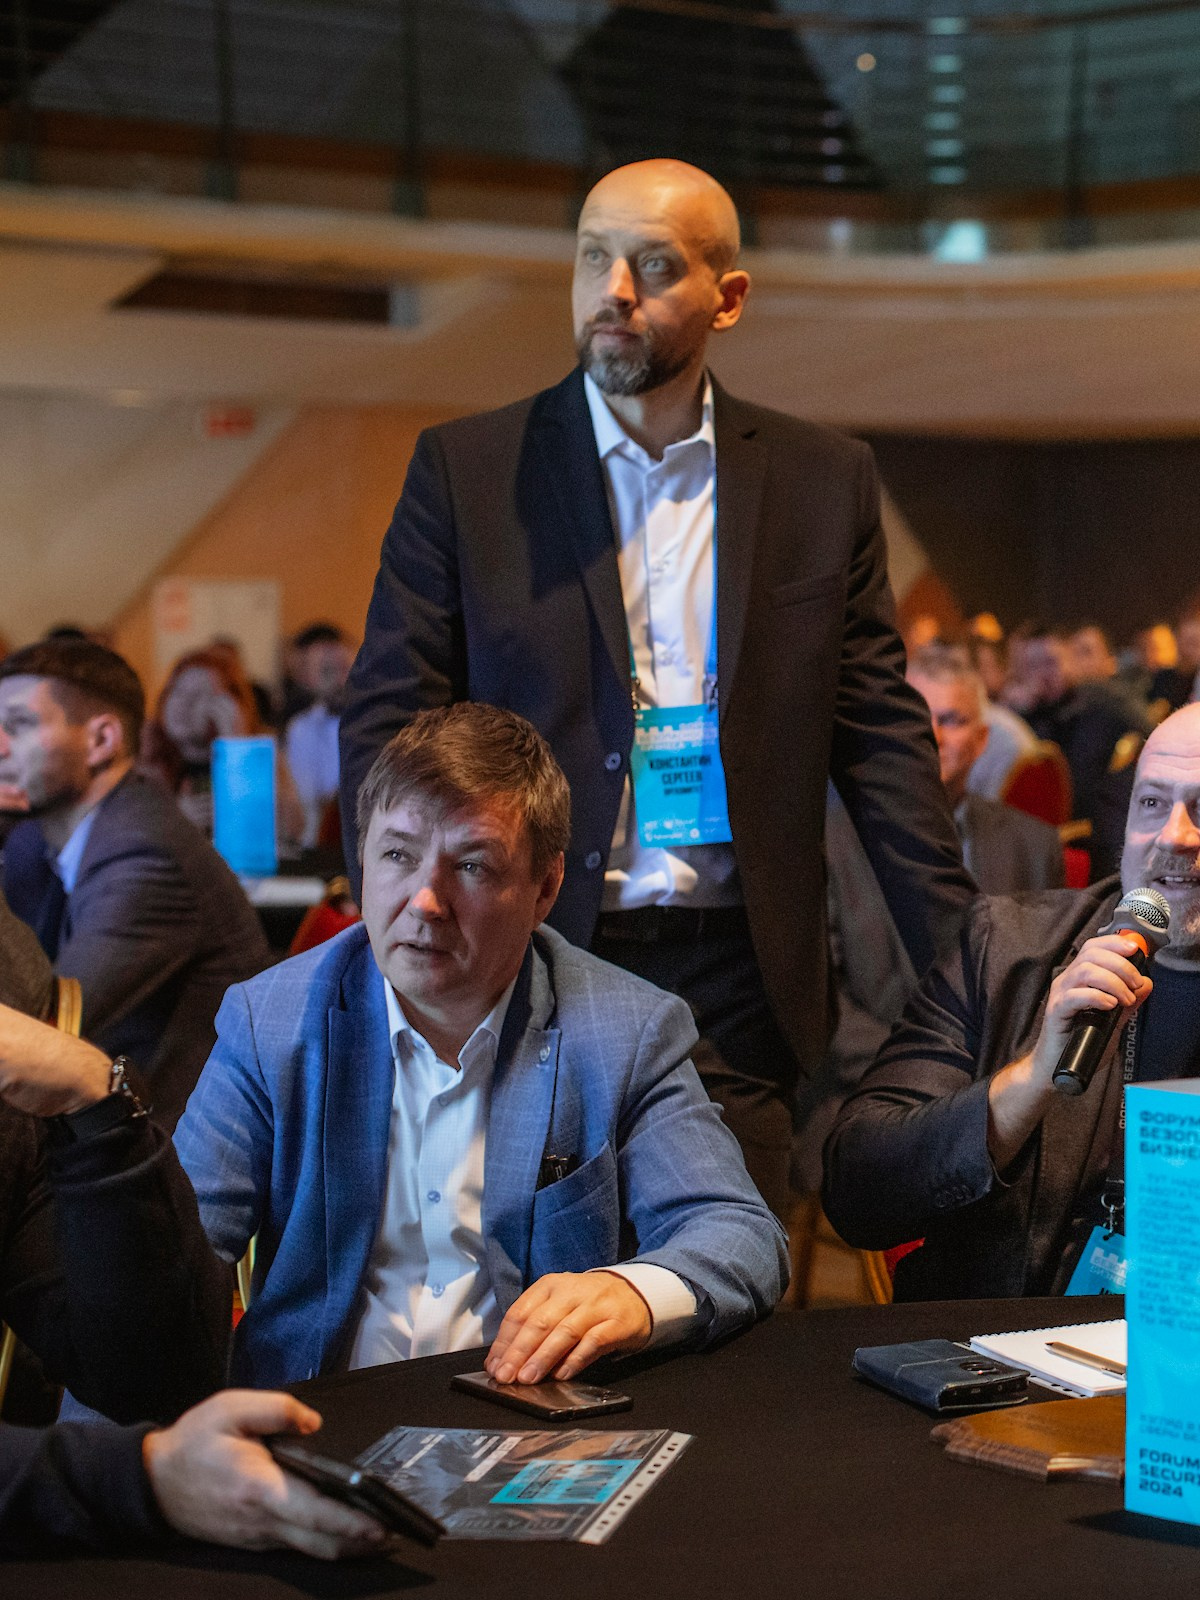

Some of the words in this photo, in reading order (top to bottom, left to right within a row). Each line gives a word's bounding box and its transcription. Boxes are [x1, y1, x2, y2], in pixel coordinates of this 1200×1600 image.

[1123, 1009, 1138, 1081] БЕЗОПАСН
[1139, 1447, 1200, 1470] FORUM
[1138, 1477, 1184, 1498] 2024
